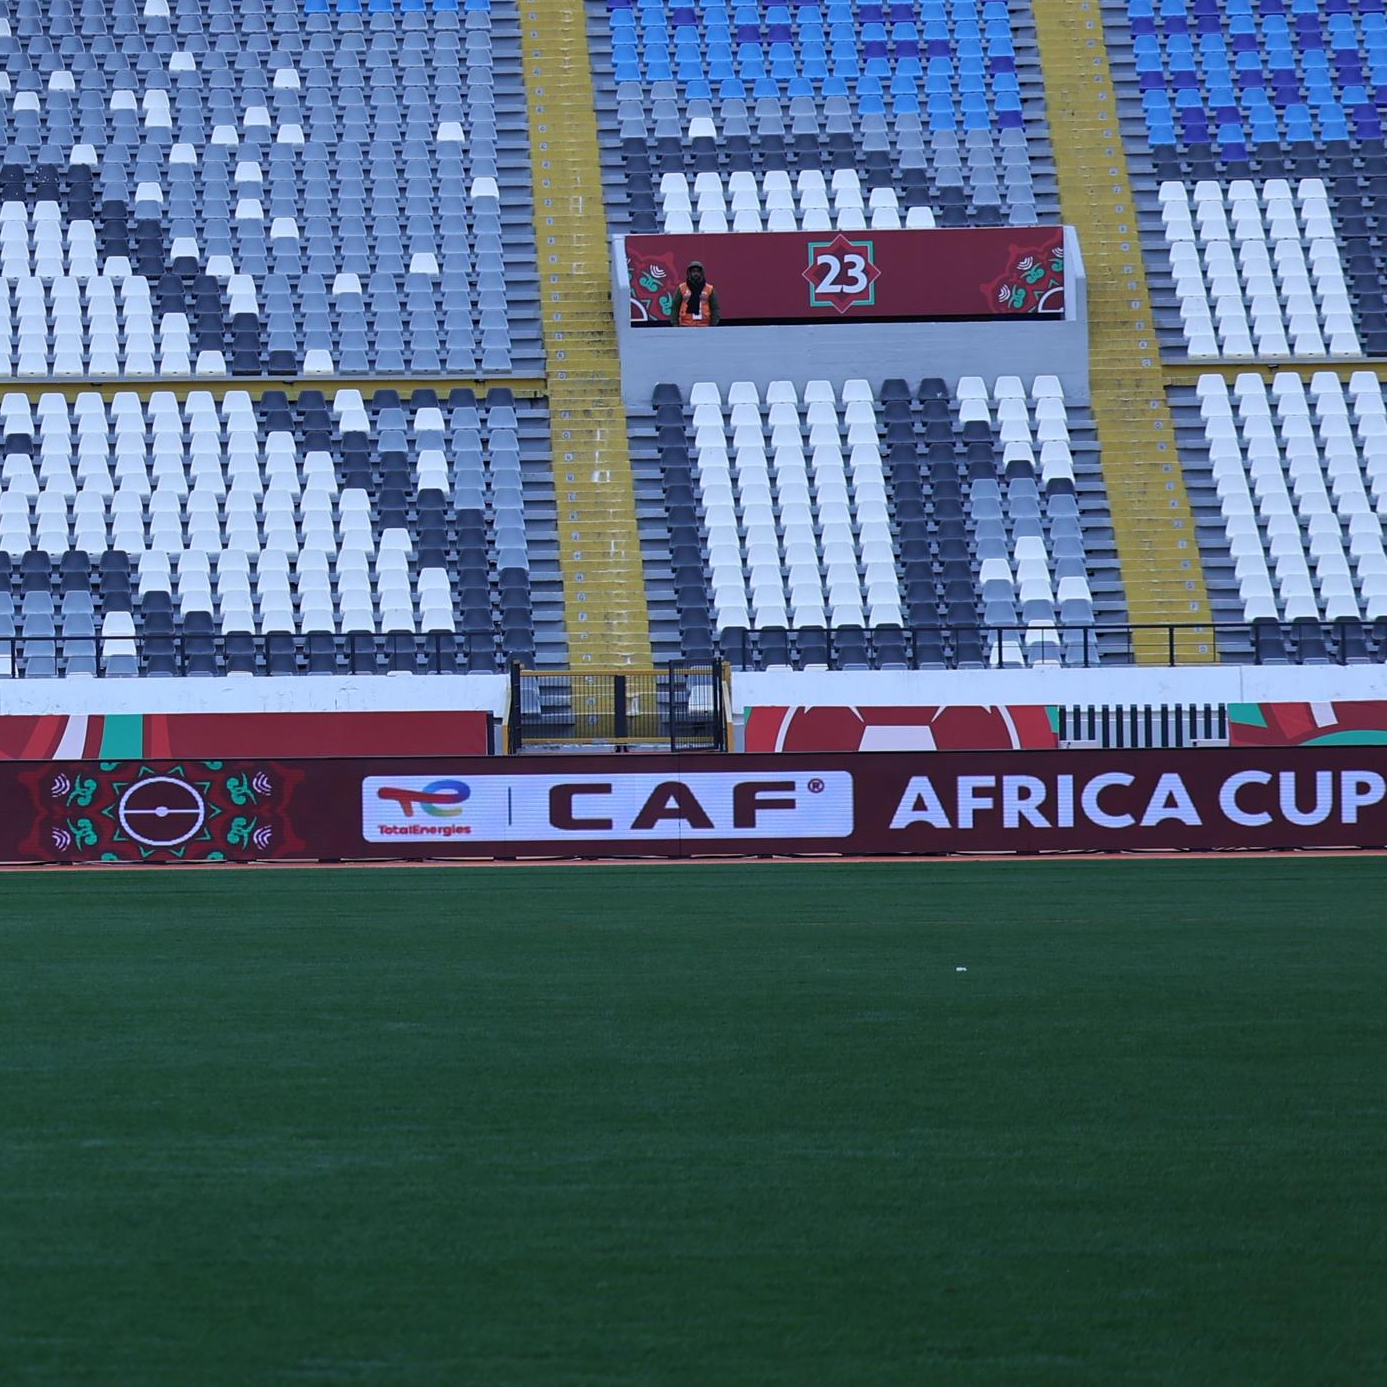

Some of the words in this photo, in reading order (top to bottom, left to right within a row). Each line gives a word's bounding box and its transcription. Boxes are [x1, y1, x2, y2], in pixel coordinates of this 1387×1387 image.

[815, 254, 867, 294] 23
[888, 772, 1203, 829] AFRICA
[1219, 770, 1386, 826] CUP
[377, 823, 472, 836] TotalEnergies
